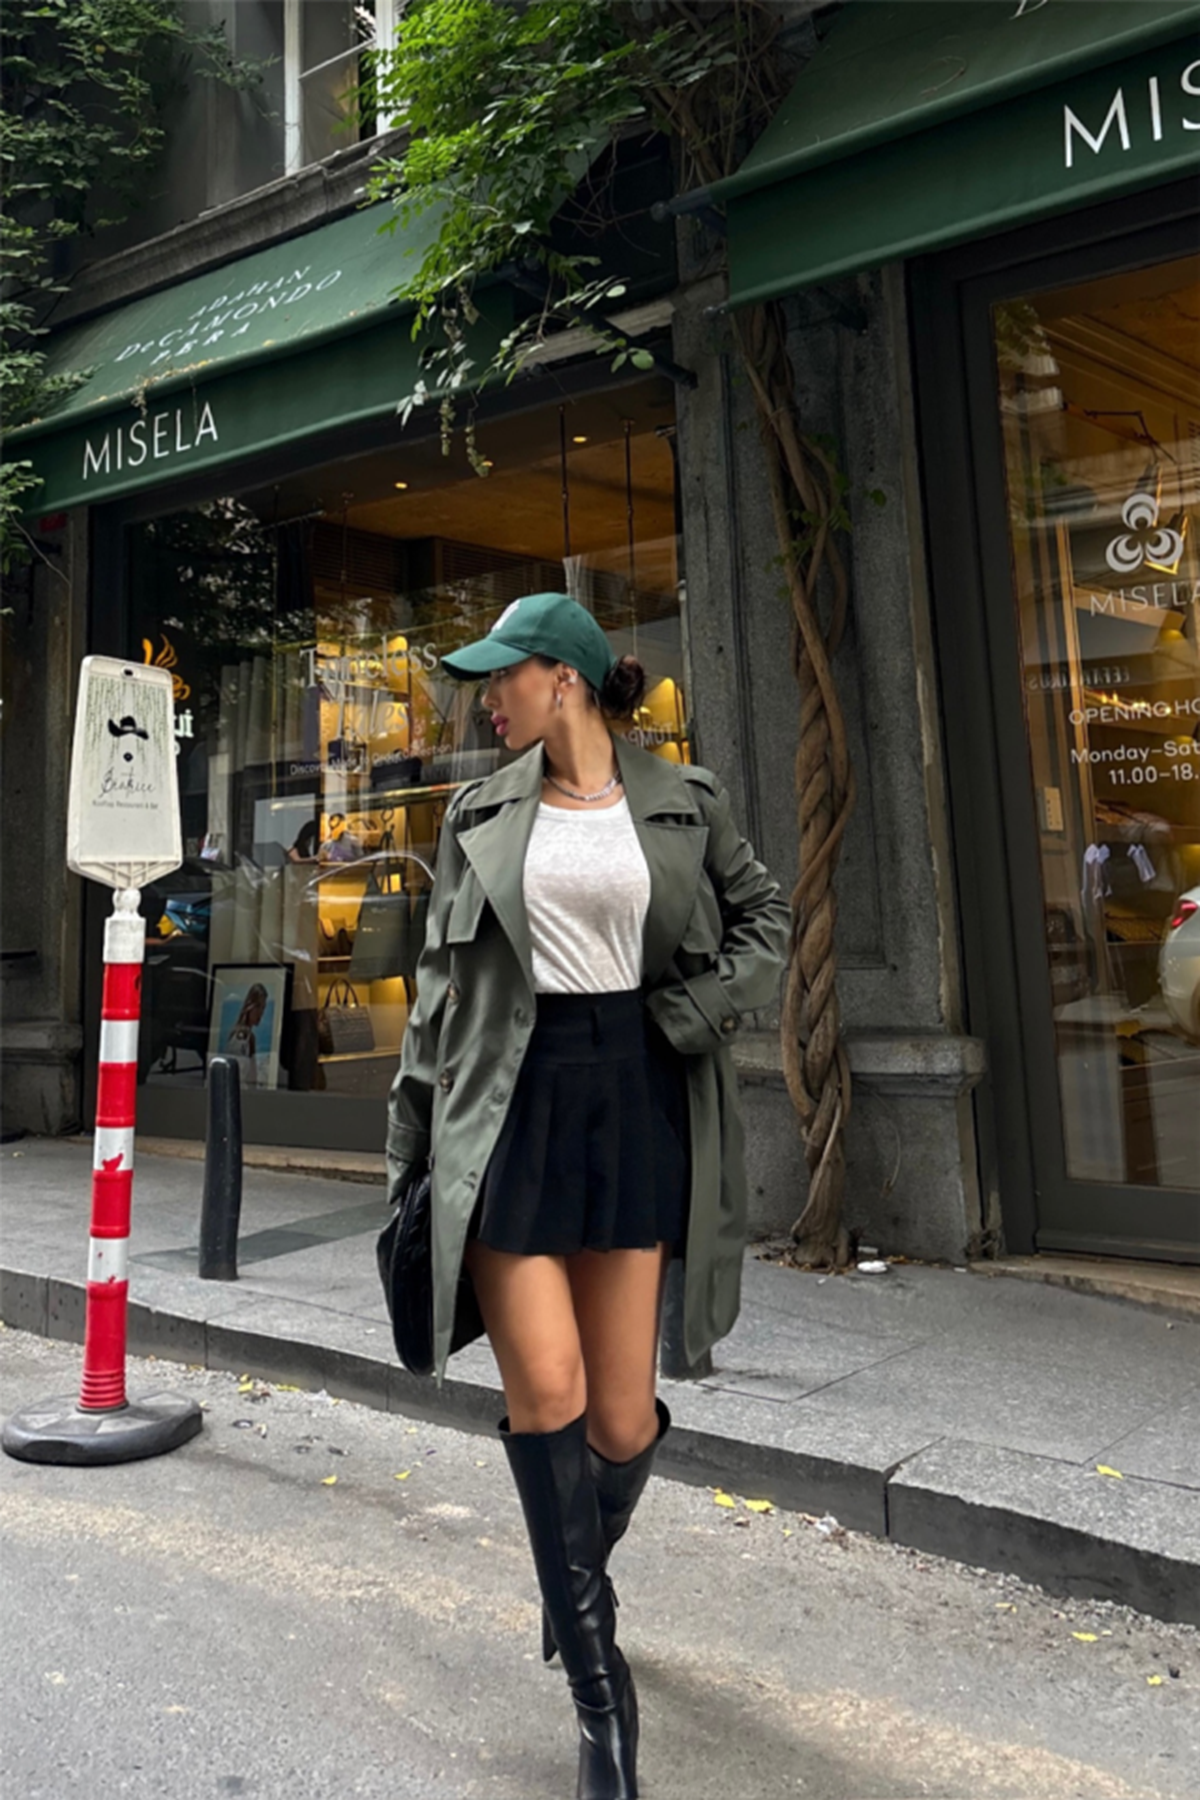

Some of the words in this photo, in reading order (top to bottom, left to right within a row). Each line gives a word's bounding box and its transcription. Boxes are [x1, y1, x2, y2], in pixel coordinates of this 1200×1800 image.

[188, 265, 312, 321] ADAHAN
[82, 401, 219, 479] MISELA
[299, 634, 438, 688] Timeless
[1068, 701, 1171, 726] OPENING
[98, 765, 157, 798] Beatrice
